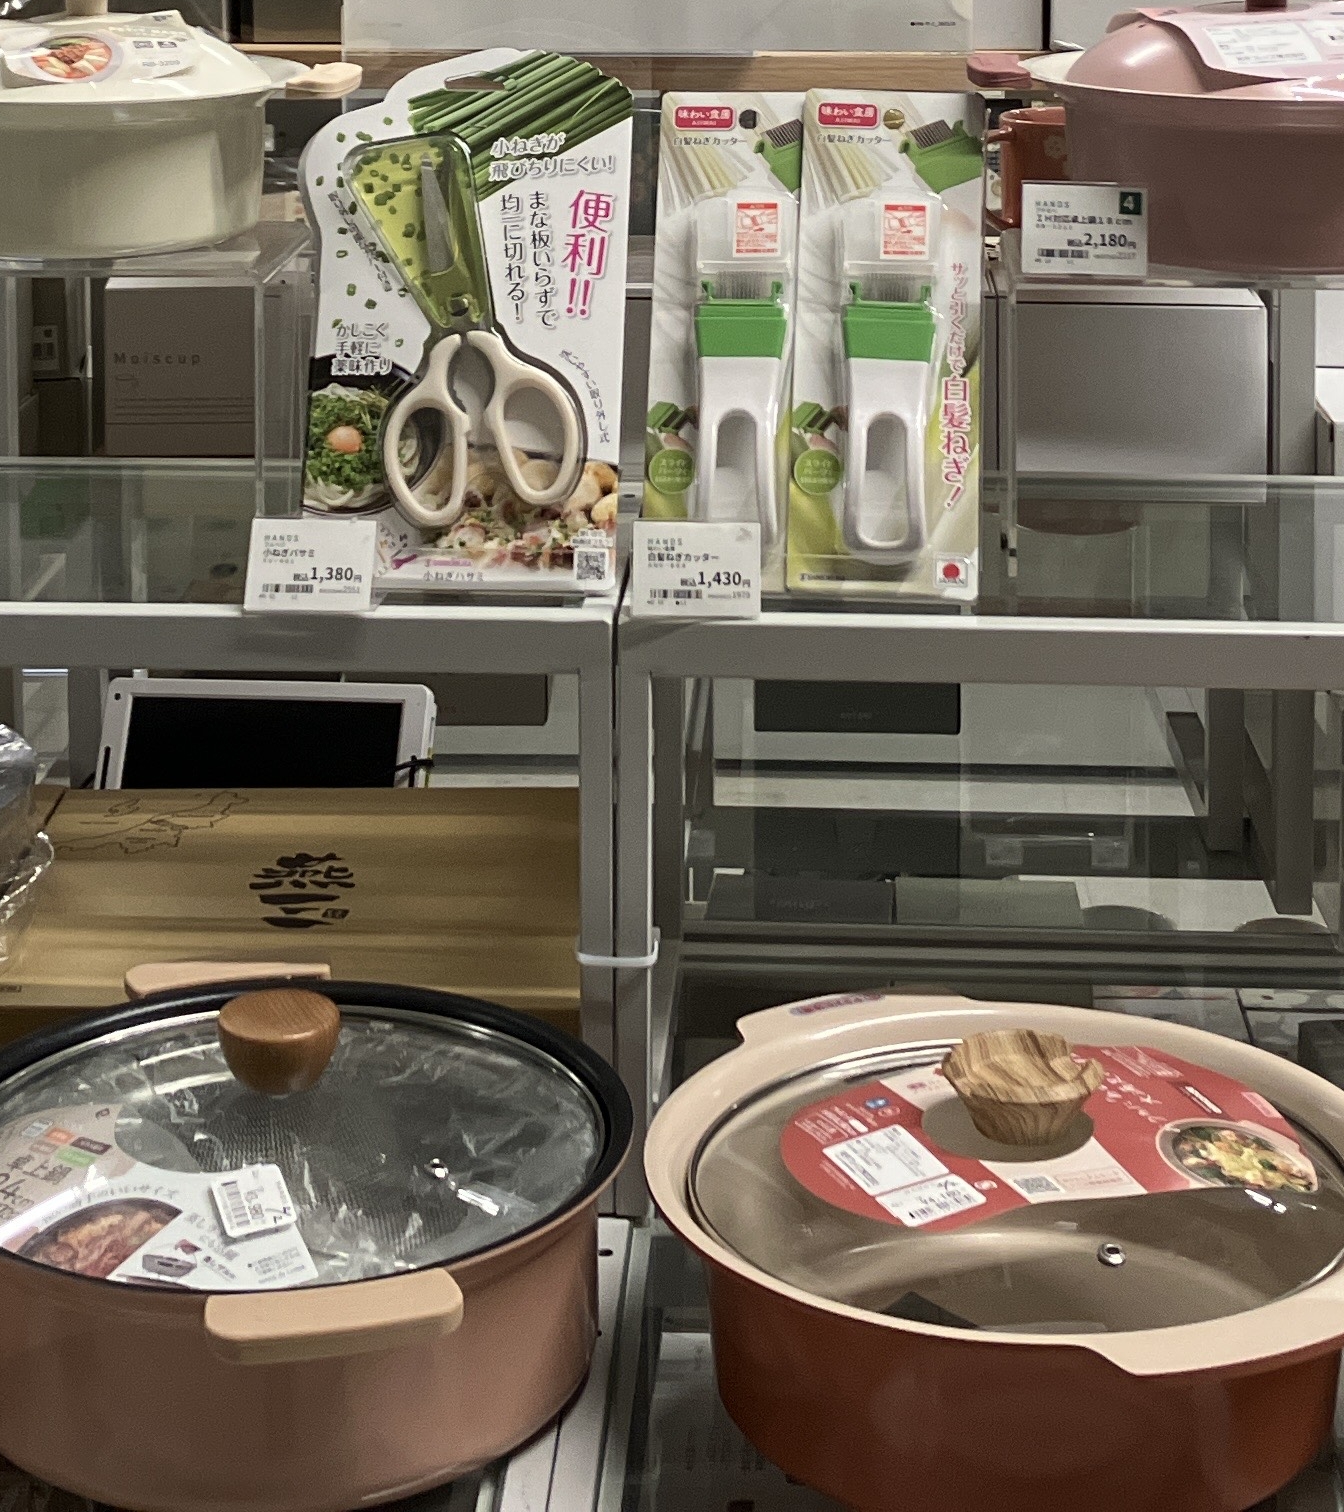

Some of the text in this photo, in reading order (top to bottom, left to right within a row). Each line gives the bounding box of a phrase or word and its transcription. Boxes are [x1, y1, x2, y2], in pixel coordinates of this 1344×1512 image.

[491, 133, 565, 157] 小ねぎが
[490, 155, 616, 181] 飛びちりにくい!
[1123, 196, 1135, 210] 4
[501, 194, 526, 321] 均一に切れる!
[529, 191, 557, 328] まな板いらずで
[337, 322, 387, 337] かしこく
[335, 340, 381, 357] 手軽に
[331, 358, 392, 375] 薬味作り
